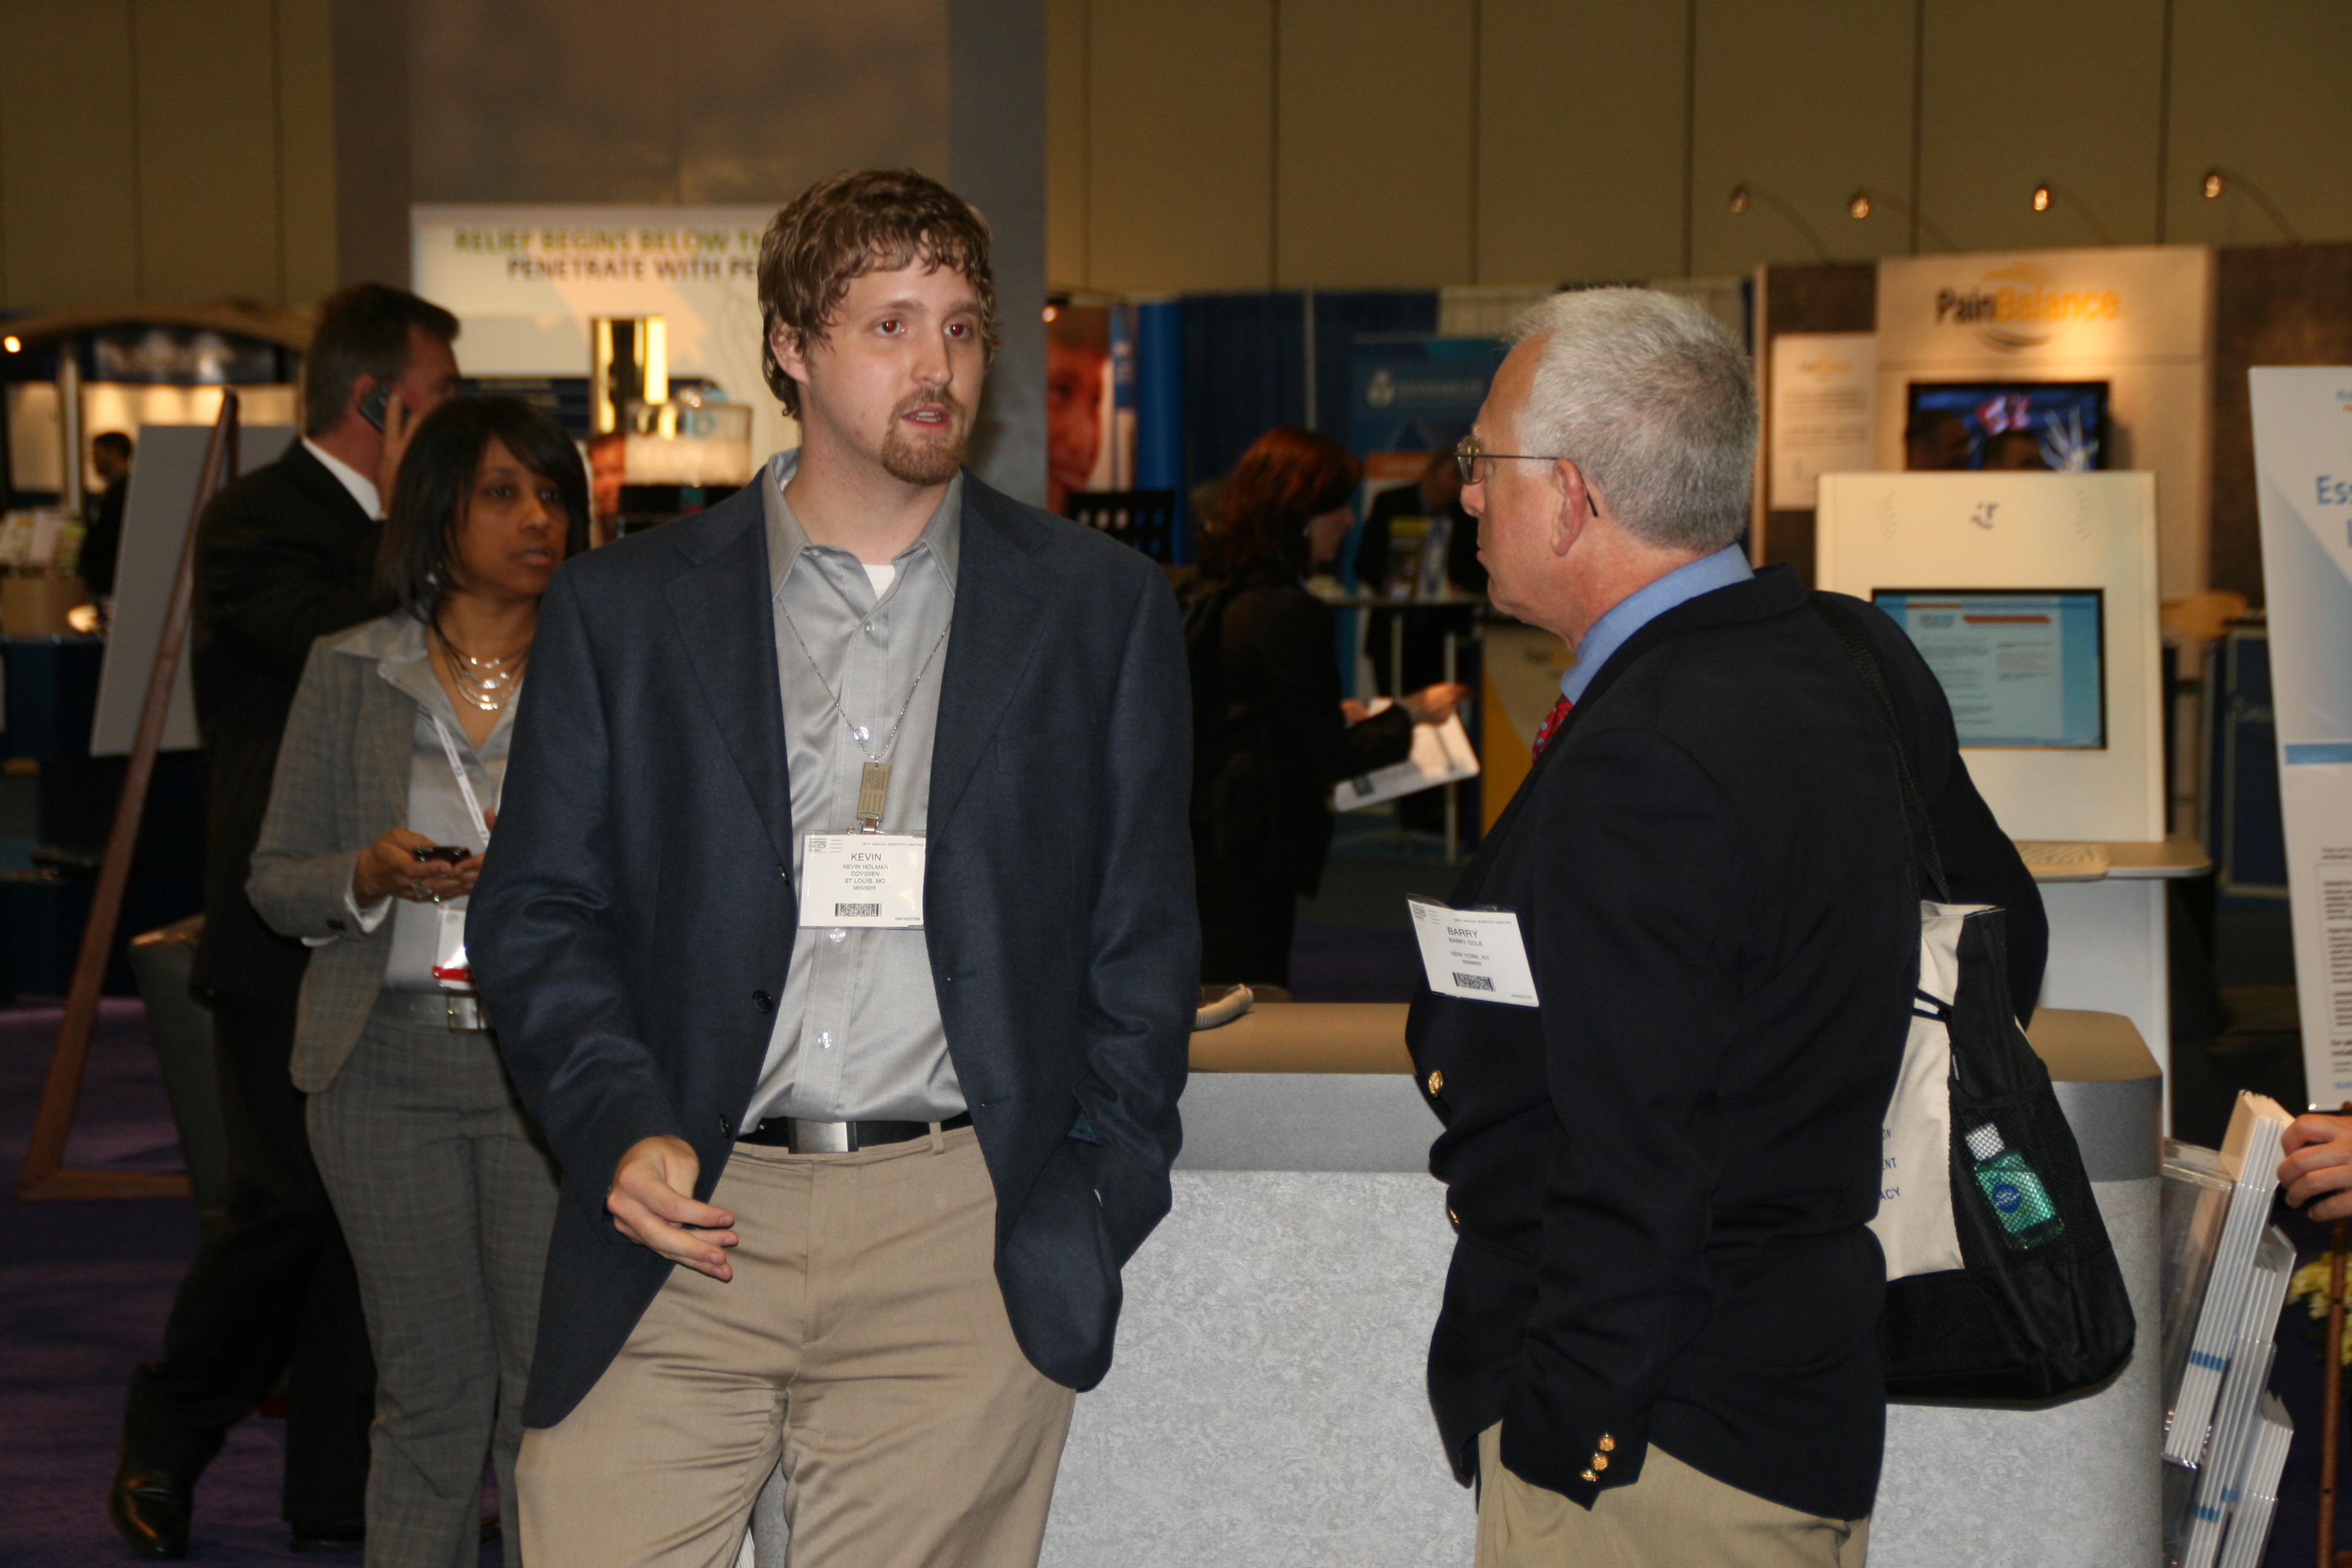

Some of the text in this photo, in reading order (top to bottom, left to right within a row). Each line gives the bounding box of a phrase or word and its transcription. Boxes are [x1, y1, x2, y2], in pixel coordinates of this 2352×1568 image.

[455, 229, 530, 253] RELIEF
[541, 229, 631, 253] BEGINS
[640, 228, 730, 253] BELOW
[507, 256, 645, 282] PENETRATE
[657, 256, 720, 281] WITH
[851, 853, 881, 861] KEVIN
[1447, 927, 1478, 938] BARRY
